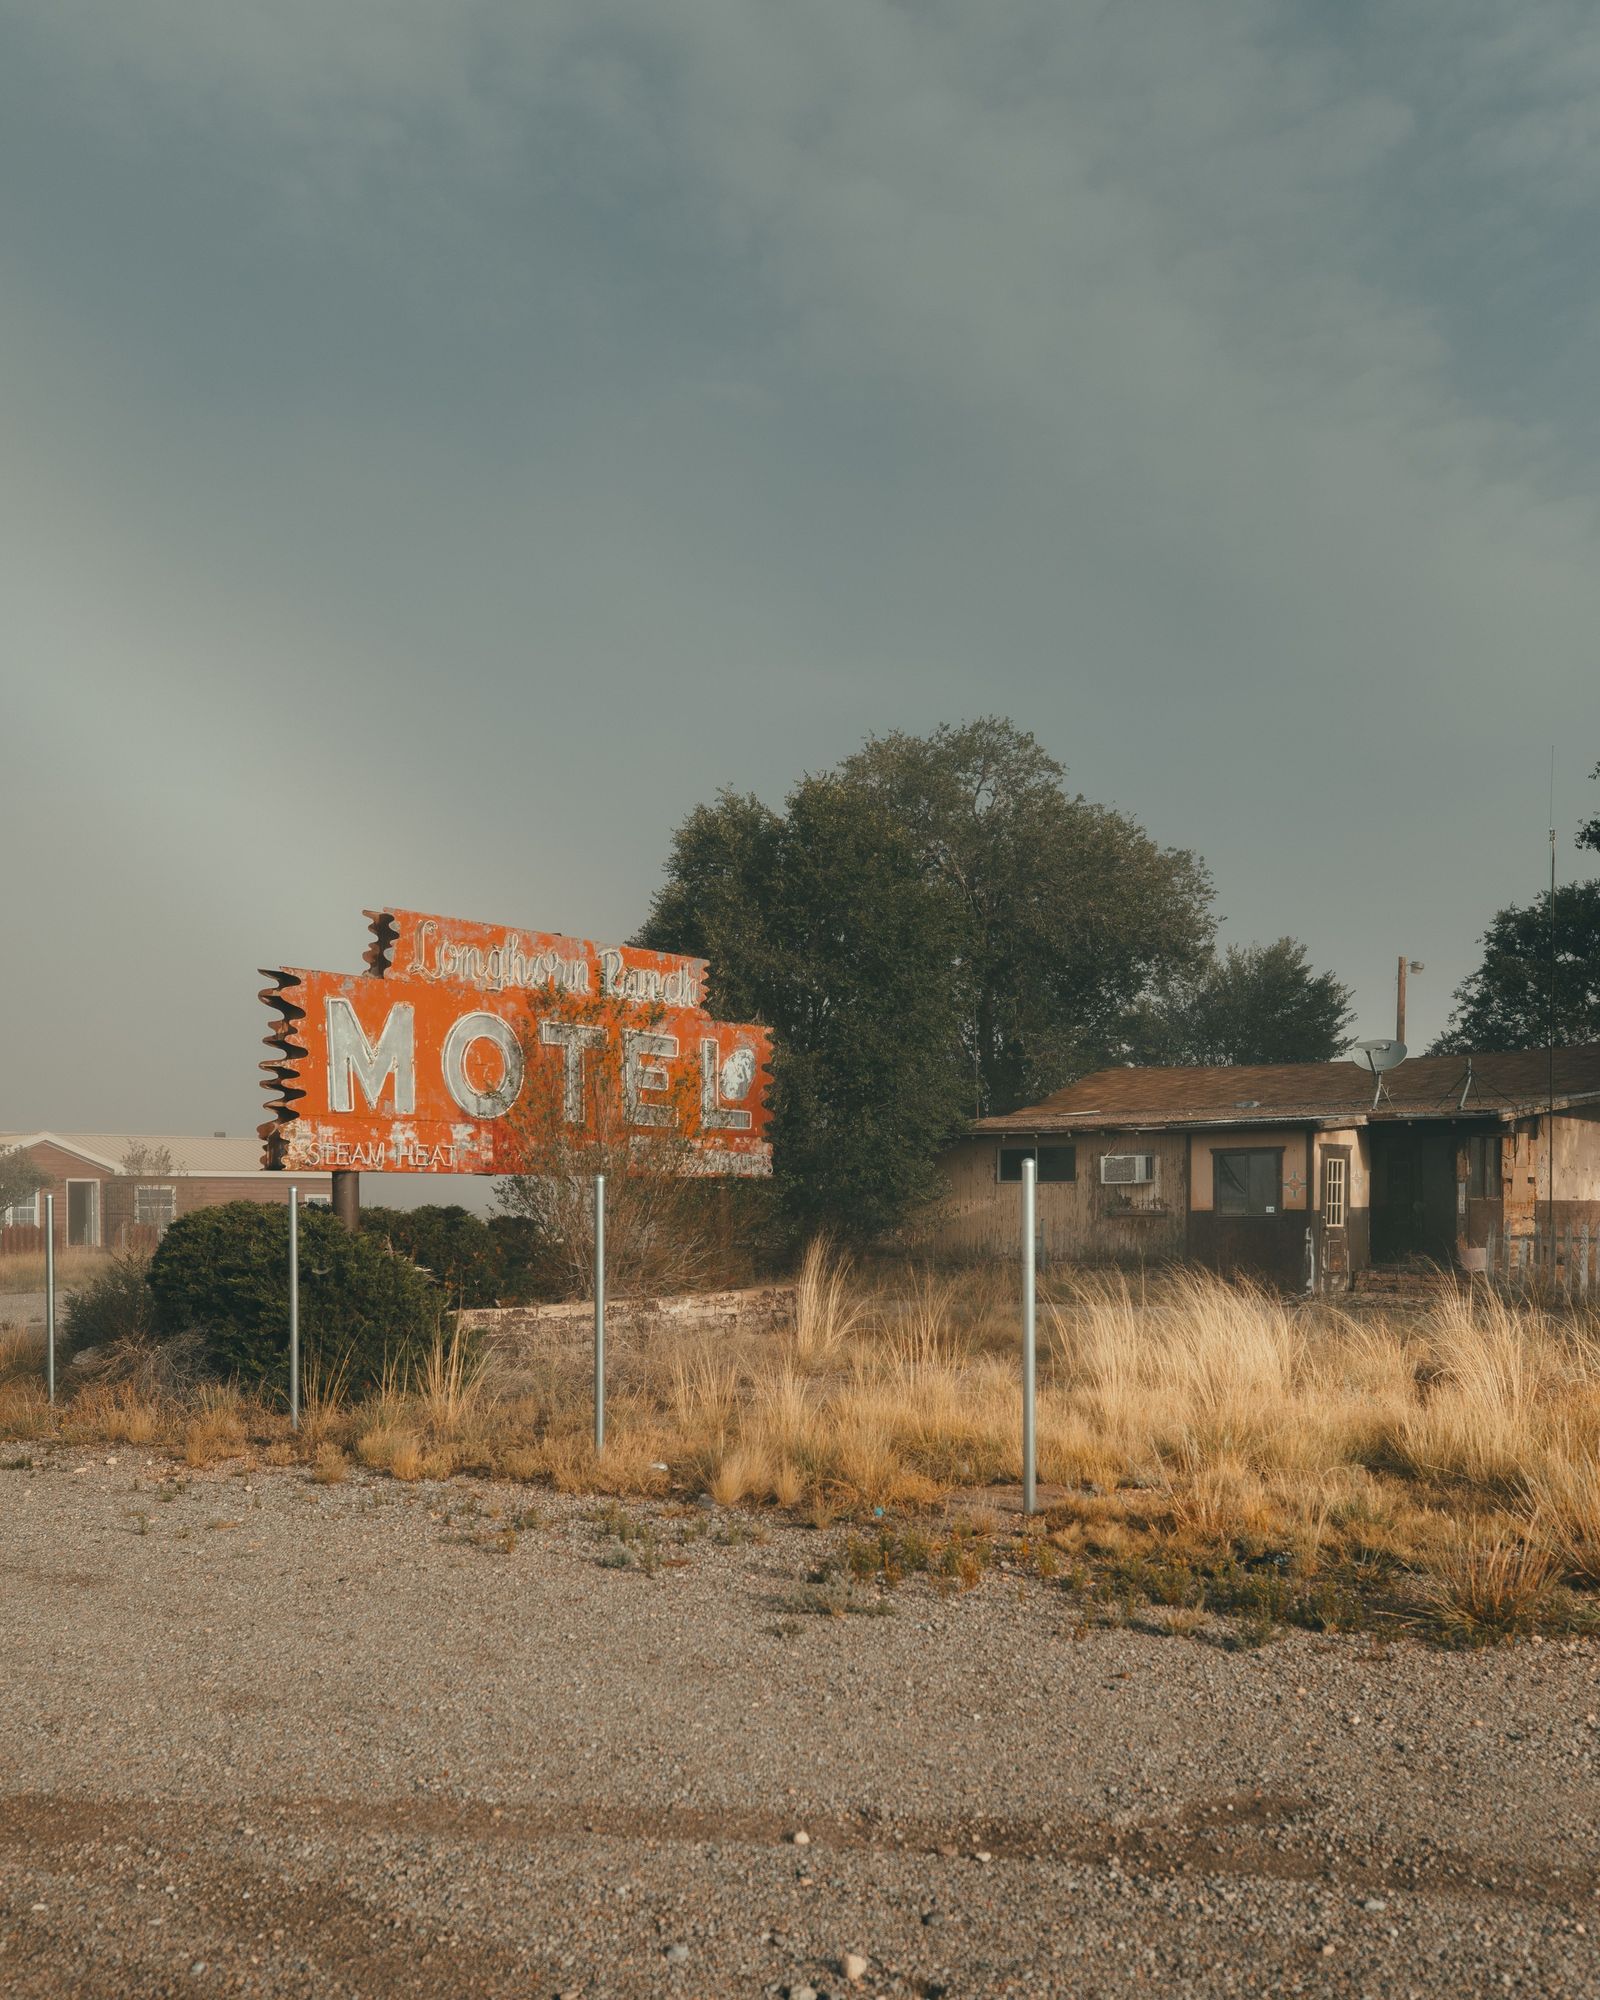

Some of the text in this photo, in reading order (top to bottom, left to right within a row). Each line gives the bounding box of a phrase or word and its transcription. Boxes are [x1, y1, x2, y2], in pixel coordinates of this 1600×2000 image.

[405, 919, 699, 1008] Longhorn Ranch
[325, 996, 752, 1129] MOTEL
[305, 1142, 457, 1169] STEAM HEAT
